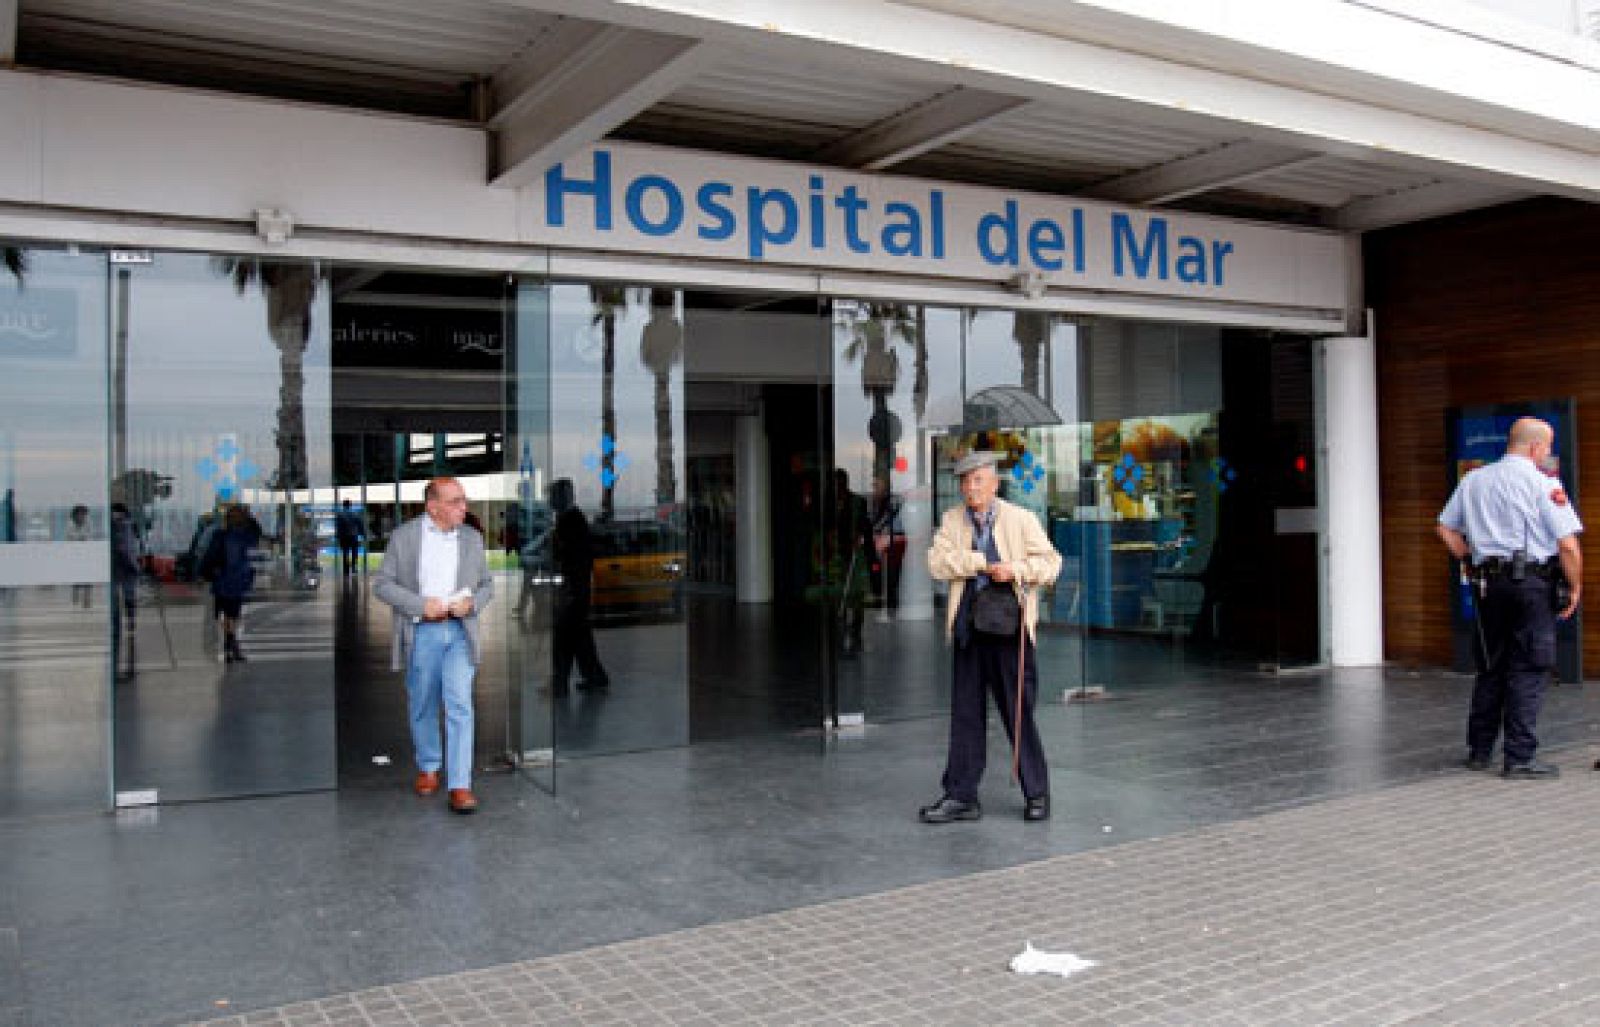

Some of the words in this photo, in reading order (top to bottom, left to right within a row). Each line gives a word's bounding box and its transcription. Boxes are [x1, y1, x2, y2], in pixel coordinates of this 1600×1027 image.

[545, 150, 945, 259] Hospital
[977, 200, 1086, 273] del
[1111, 213, 1234, 286] Mar
